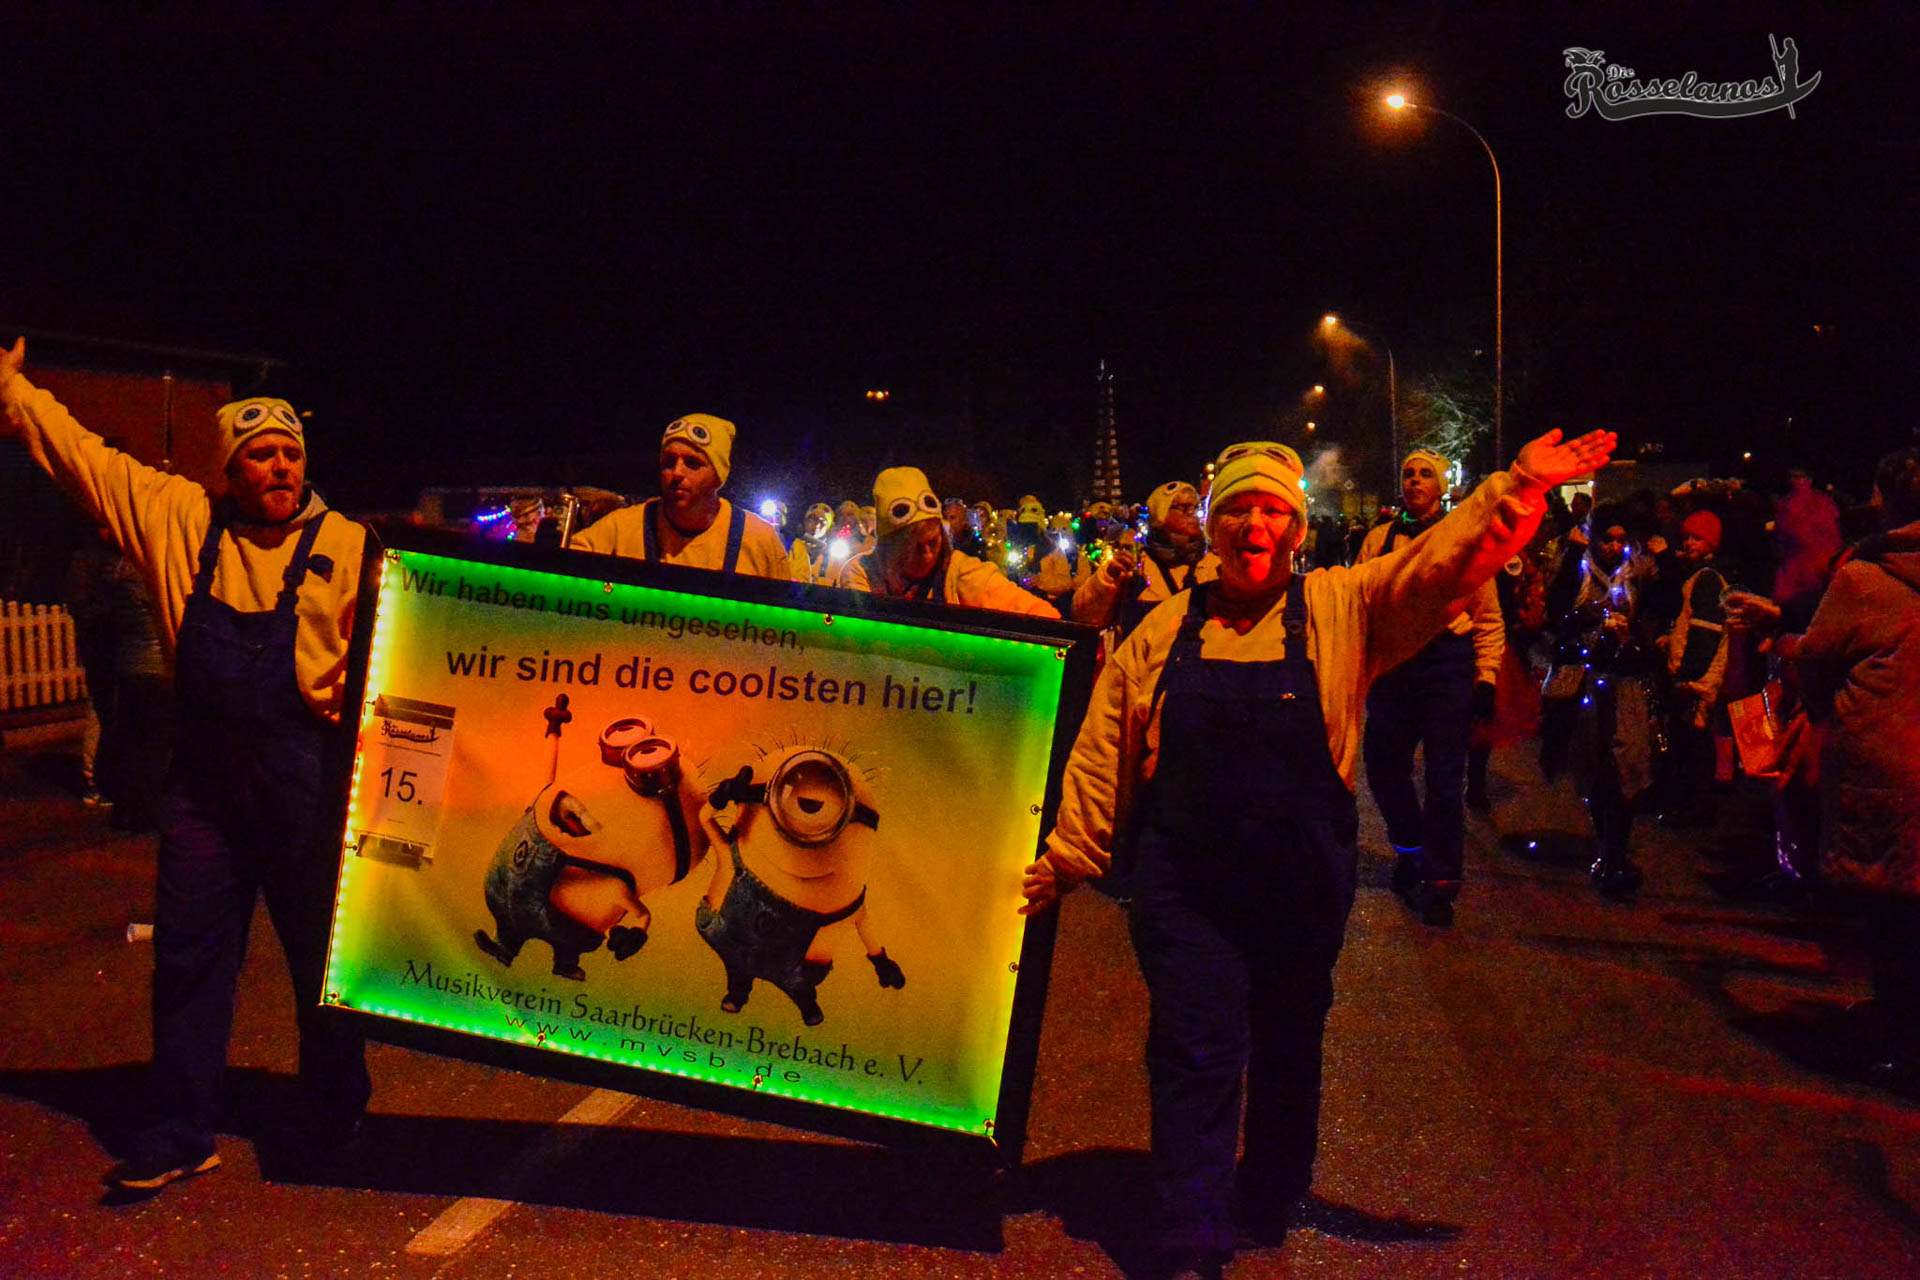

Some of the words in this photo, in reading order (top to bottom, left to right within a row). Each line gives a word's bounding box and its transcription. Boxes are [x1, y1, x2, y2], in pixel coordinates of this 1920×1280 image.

[401, 566, 449, 597] Wir
[457, 576, 546, 612] haben
[556, 597, 610, 621] uns
[621, 606, 805, 655] umgesehen,
[446, 645, 505, 679] wir
[516, 650, 602, 686] sind
[615, 656, 675, 691] die
[688, 666, 867, 706] coolsten
[881, 674, 978, 714] hier!
[381, 767, 423, 806] 15.
[400, 959, 562, 1015] Musikverein
[569, 993, 855, 1072] Saarbrücken-Brebach
[863, 1058, 885, 1078] e.
[897, 1053, 923, 1085] V.
